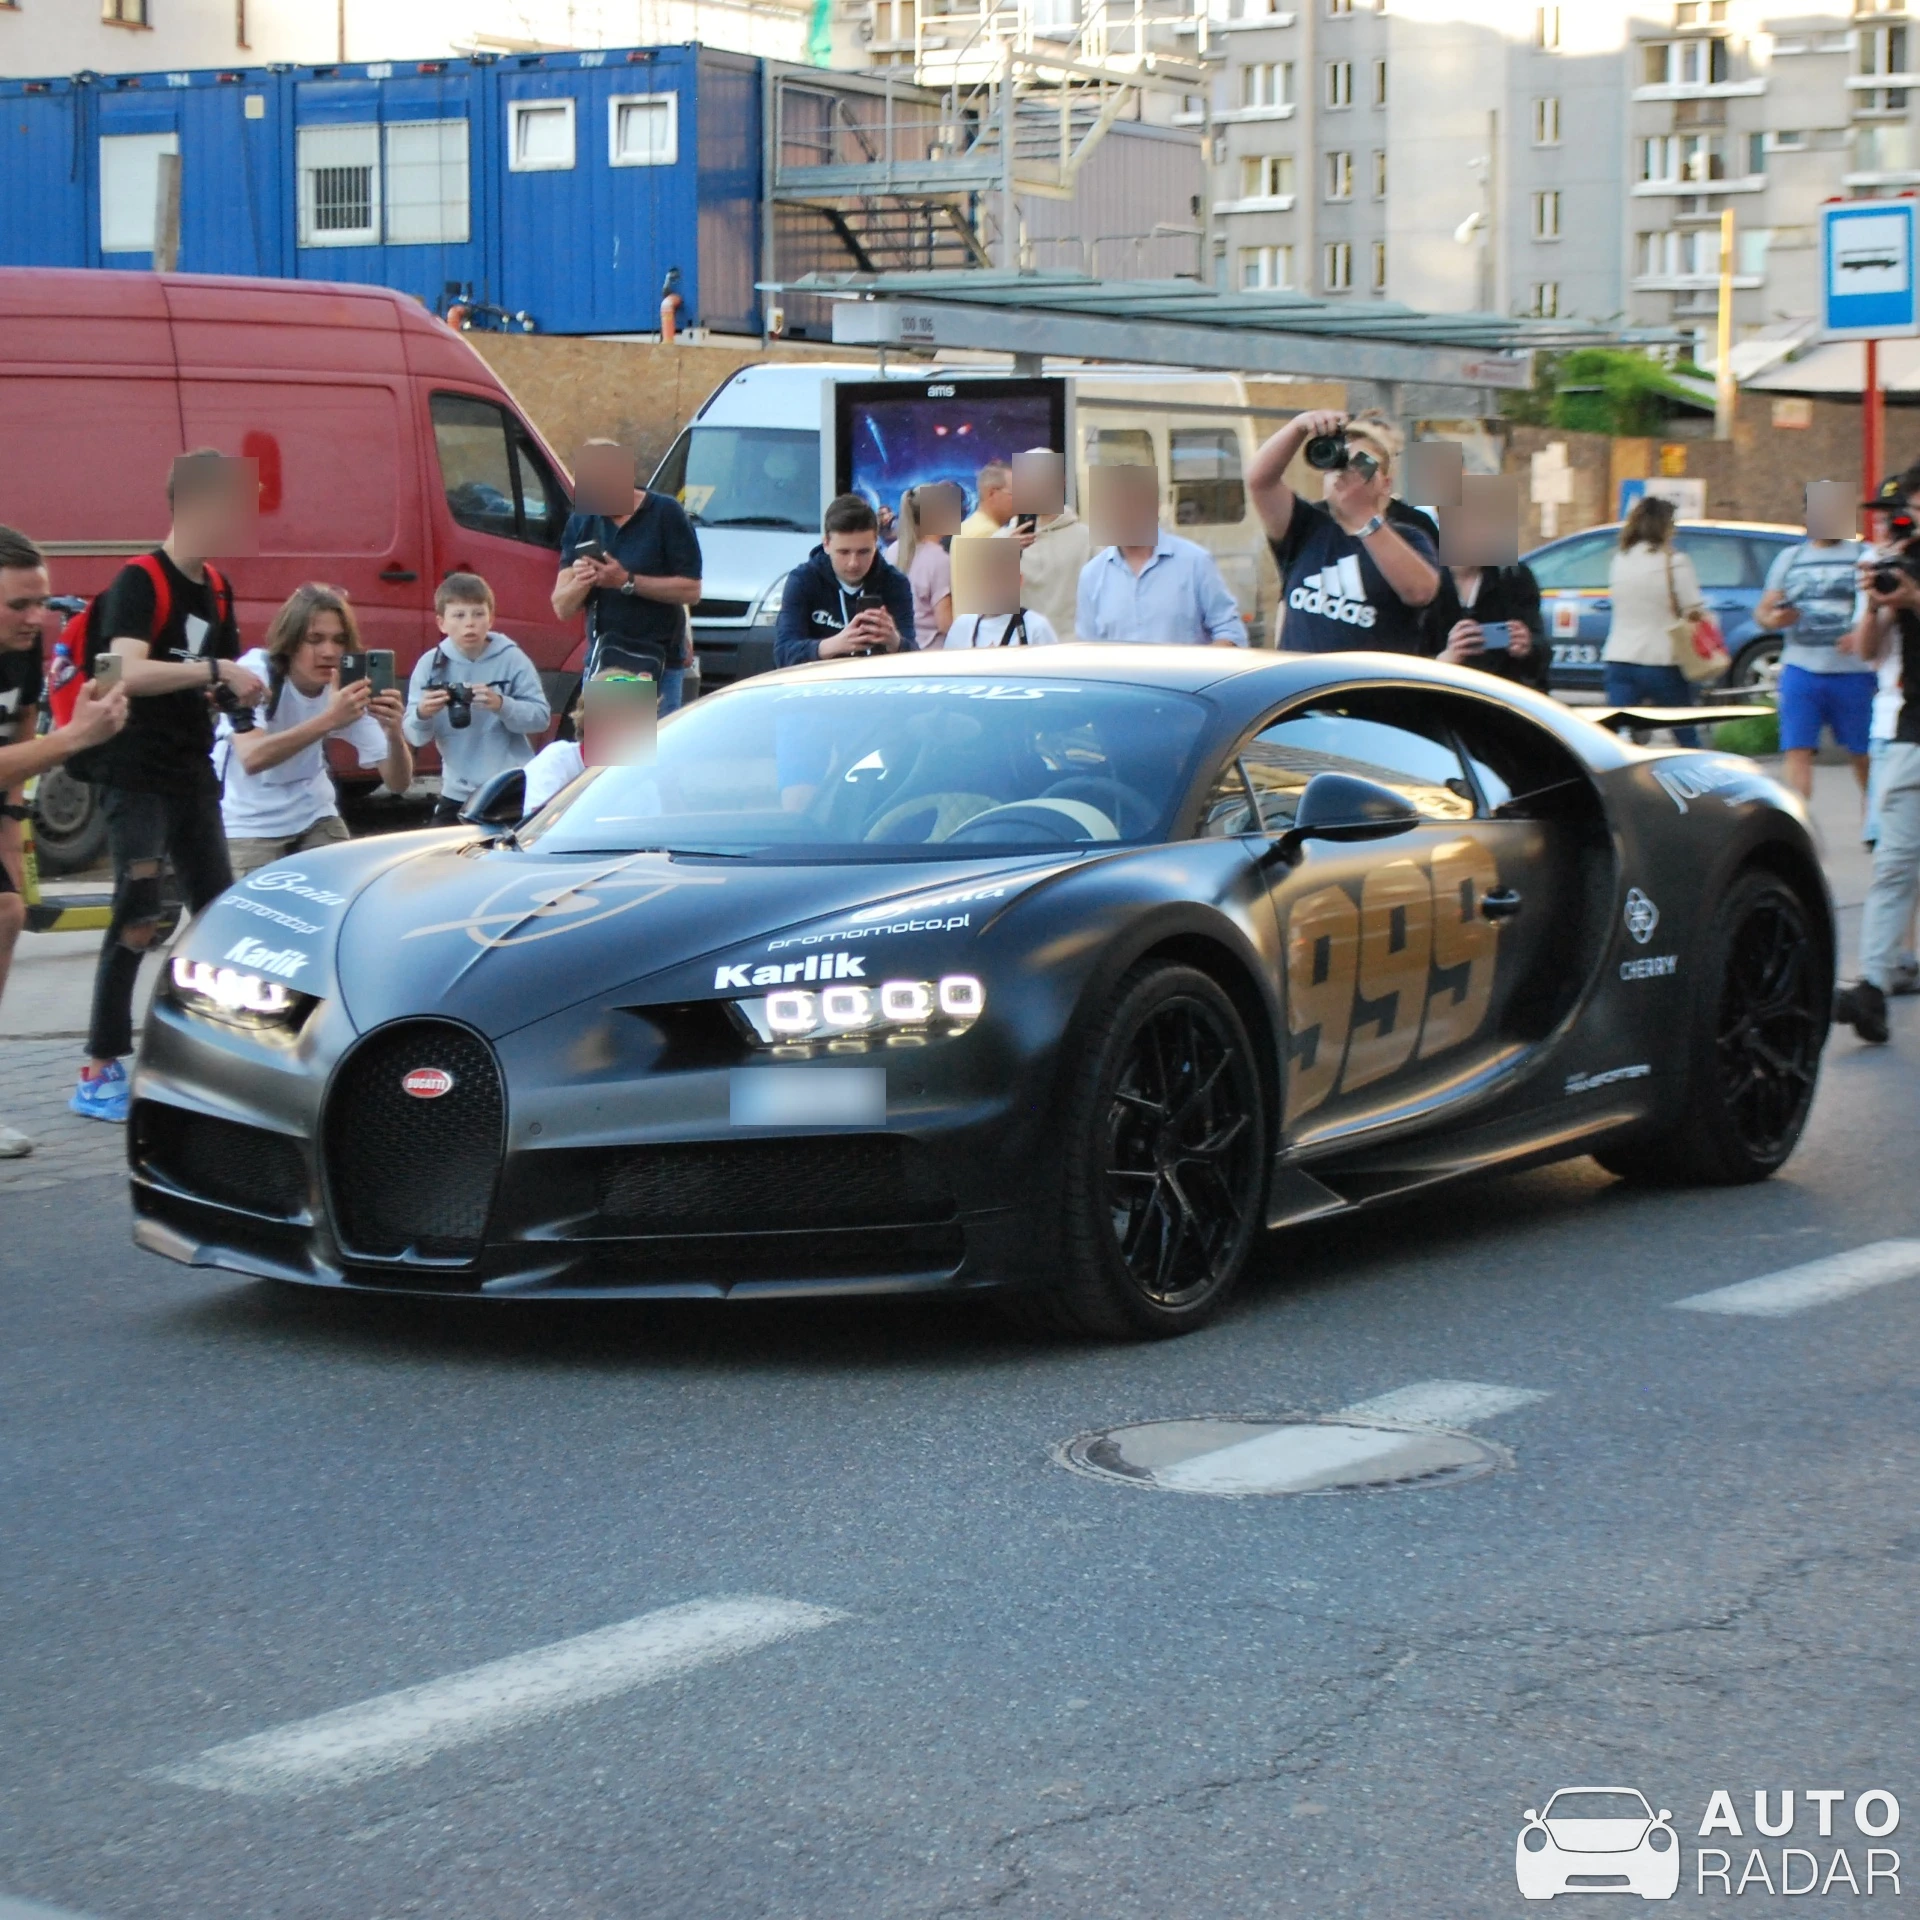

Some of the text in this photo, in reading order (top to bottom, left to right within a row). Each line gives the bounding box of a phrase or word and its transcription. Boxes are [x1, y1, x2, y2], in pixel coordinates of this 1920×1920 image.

[928, 384, 956, 398] ams
[1289, 587, 1378, 628] adidas
[768, 913, 970, 951] promomoto.pl
[223, 936, 309, 979] Karlik
[714, 952, 867, 989] Karlik
[1620, 955, 1679, 981] CHERRY
[1281, 835, 1498, 1133] 999
[407, 1077, 446, 1090] BUGATTI
